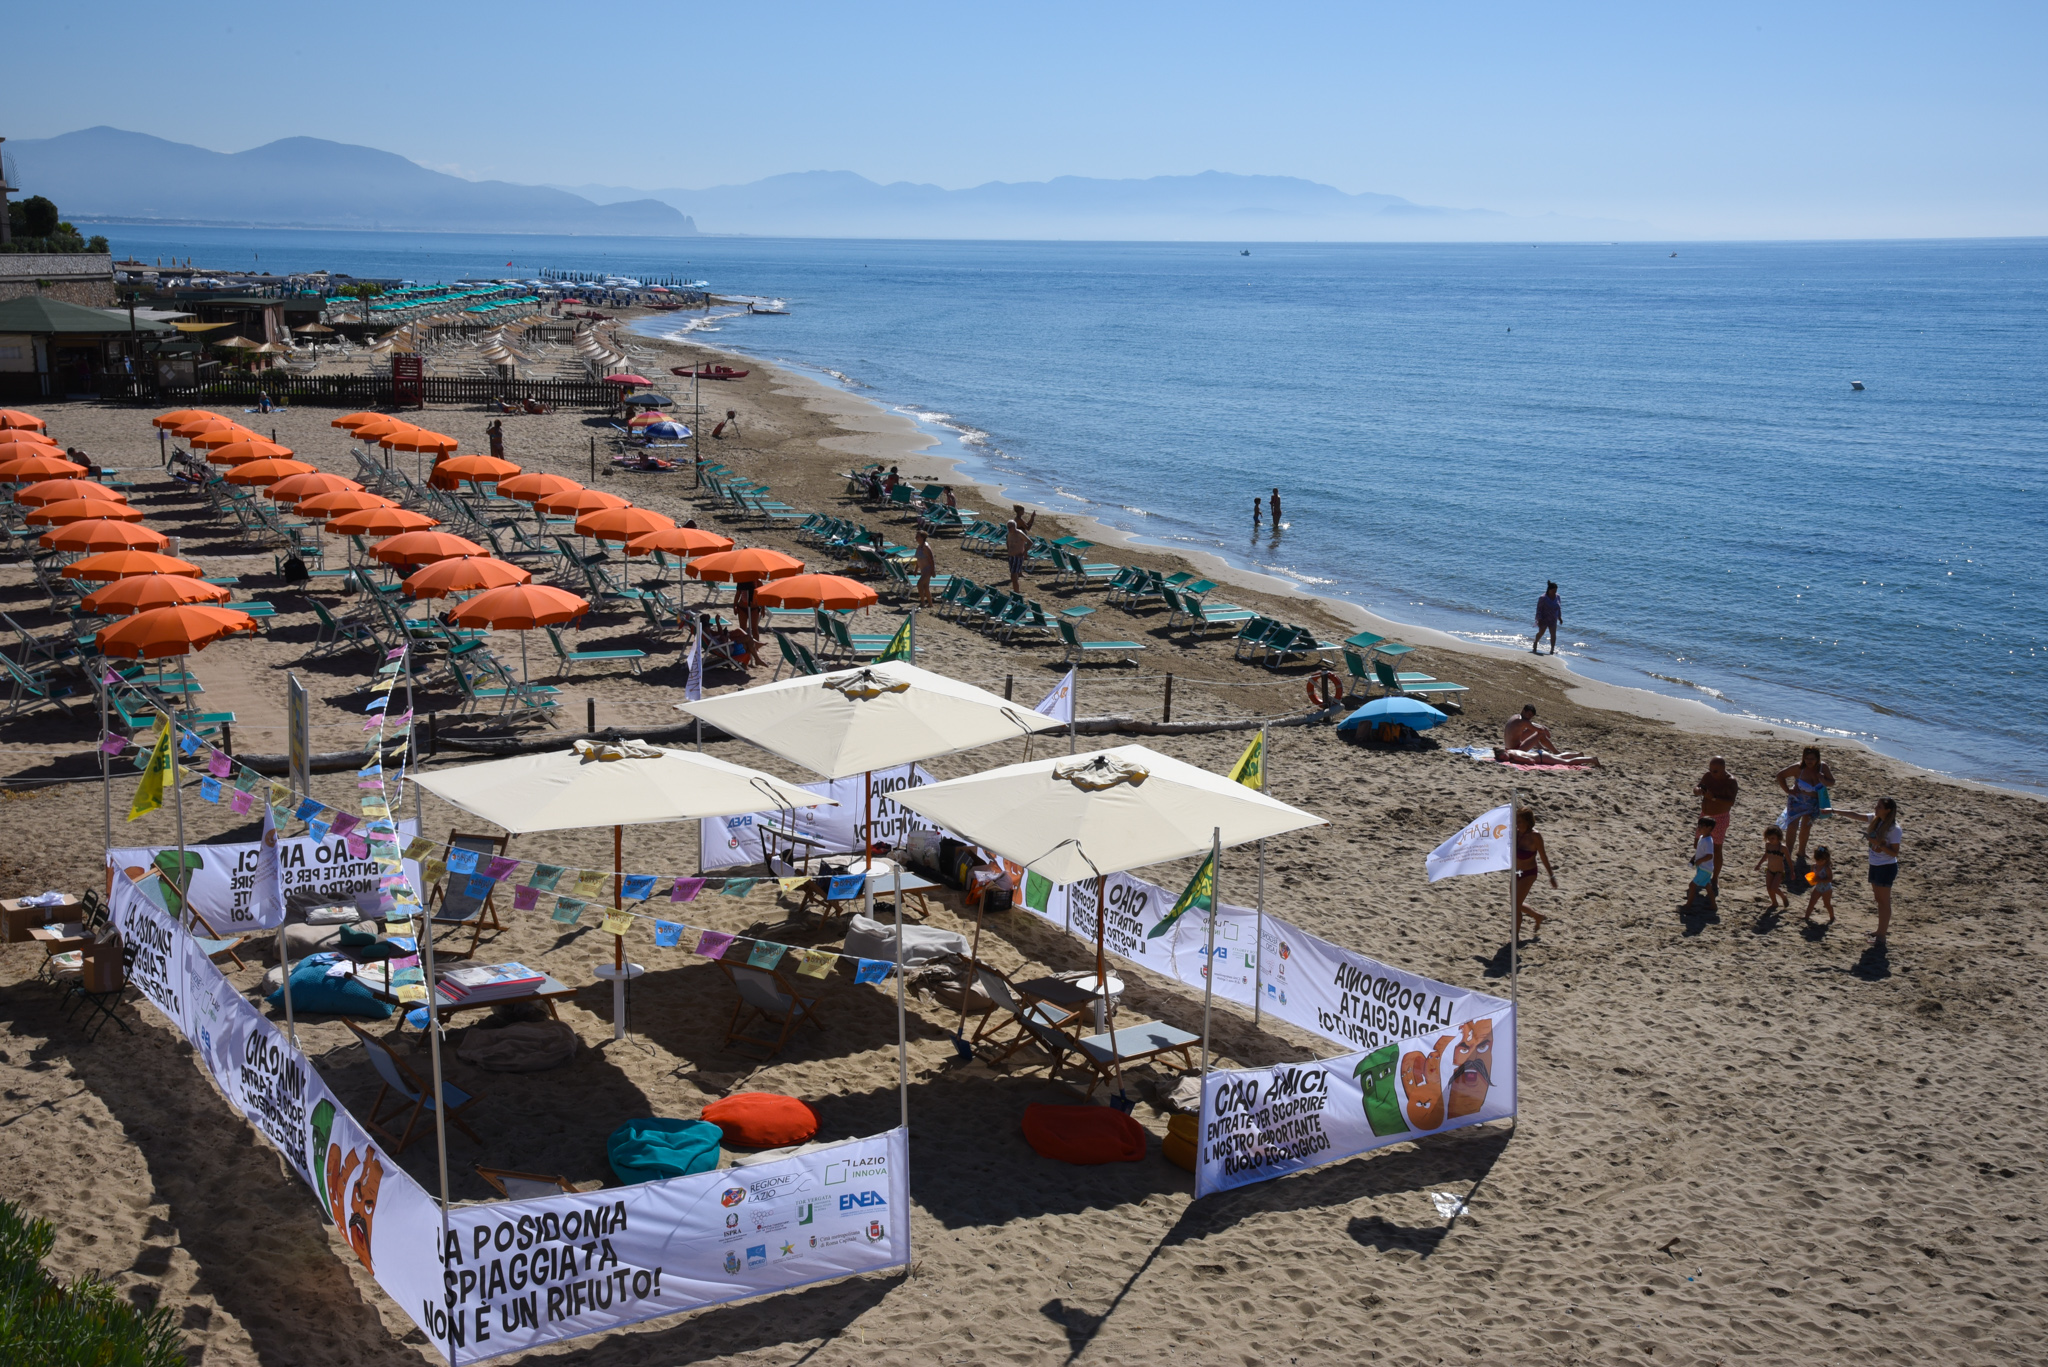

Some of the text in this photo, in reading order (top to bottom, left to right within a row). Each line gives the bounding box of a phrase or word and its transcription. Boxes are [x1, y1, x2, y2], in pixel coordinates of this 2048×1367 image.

[124, 902, 137, 931] LA
[246, 1029, 280, 1076] CIAO
[1214, 1068, 1329, 1117] CIAO AMICI,
[1207, 1113, 1254, 1141] ENTRATE
[1273, 1096, 1327, 1123] SCOPRIRE
[1212, 1132, 1254, 1161] NOSTRO
[1225, 1132, 1331, 1176] RUOLO ECOLOGICO!
[852, 1157, 886, 1167] LAZIO
[852, 1168, 887, 1178] INNOVA
[748, 1189, 776, 1203] LAZIO
[750, 1175, 791, 1194] REGIONE
[807, 1194, 832, 1203] VERGATA
[839, 1190, 887, 1211] ENEA
[437, 1200, 628, 1268] LA POSIDONIA
[723, 1228, 742, 1237] ISPRA
[443, 1238, 618, 1309] SPIAGGIATA
[423, 1266, 662, 1348] NON È UN RIFIUTO!
